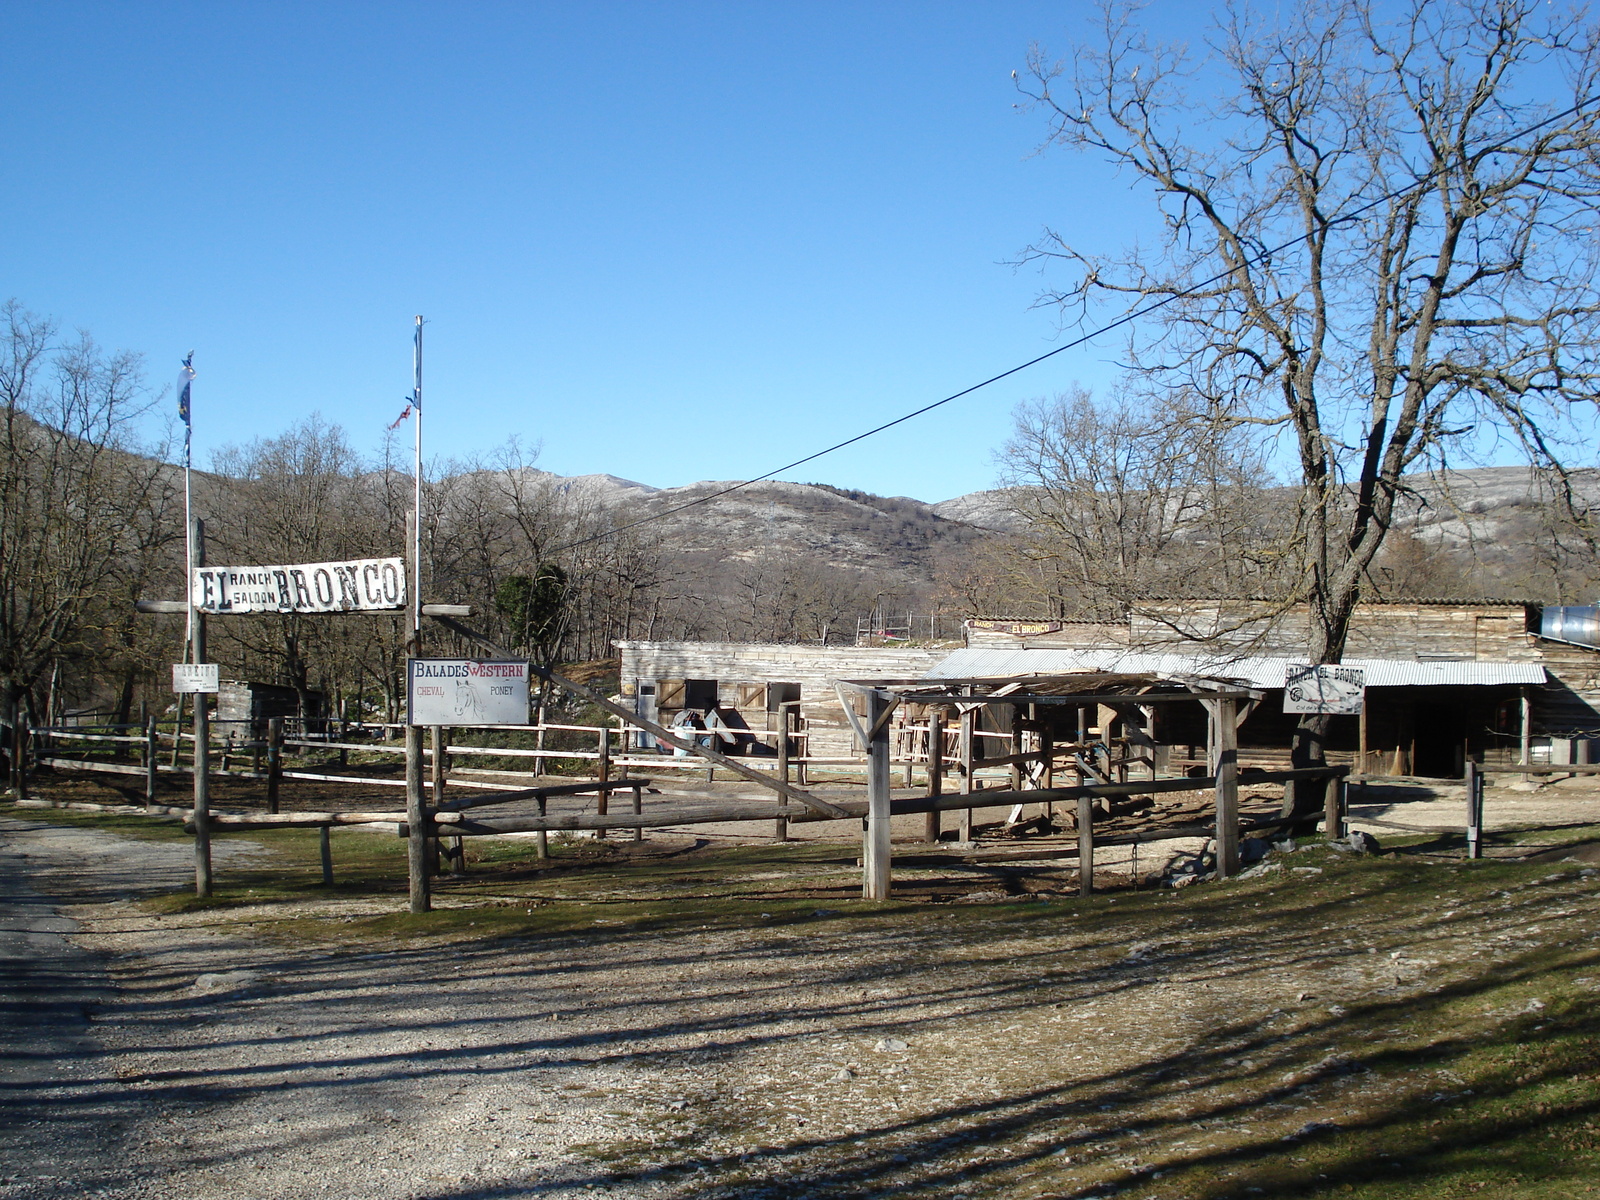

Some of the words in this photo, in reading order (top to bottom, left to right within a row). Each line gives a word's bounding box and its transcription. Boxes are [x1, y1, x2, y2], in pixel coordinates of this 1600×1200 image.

[230, 572, 272, 586] RANCH
[200, 571, 233, 610] EL
[272, 563, 399, 609] BRONCO
[233, 591, 276, 604] SALOON
[415, 662, 469, 678] BALADES
[465, 662, 524, 677] WESTERN
[1319, 667, 1329, 678] EL
[1335, 668, 1364, 689] BRONCO
[417, 686, 444, 696] CHEVAL
[490, 686, 514, 696] PONEY
